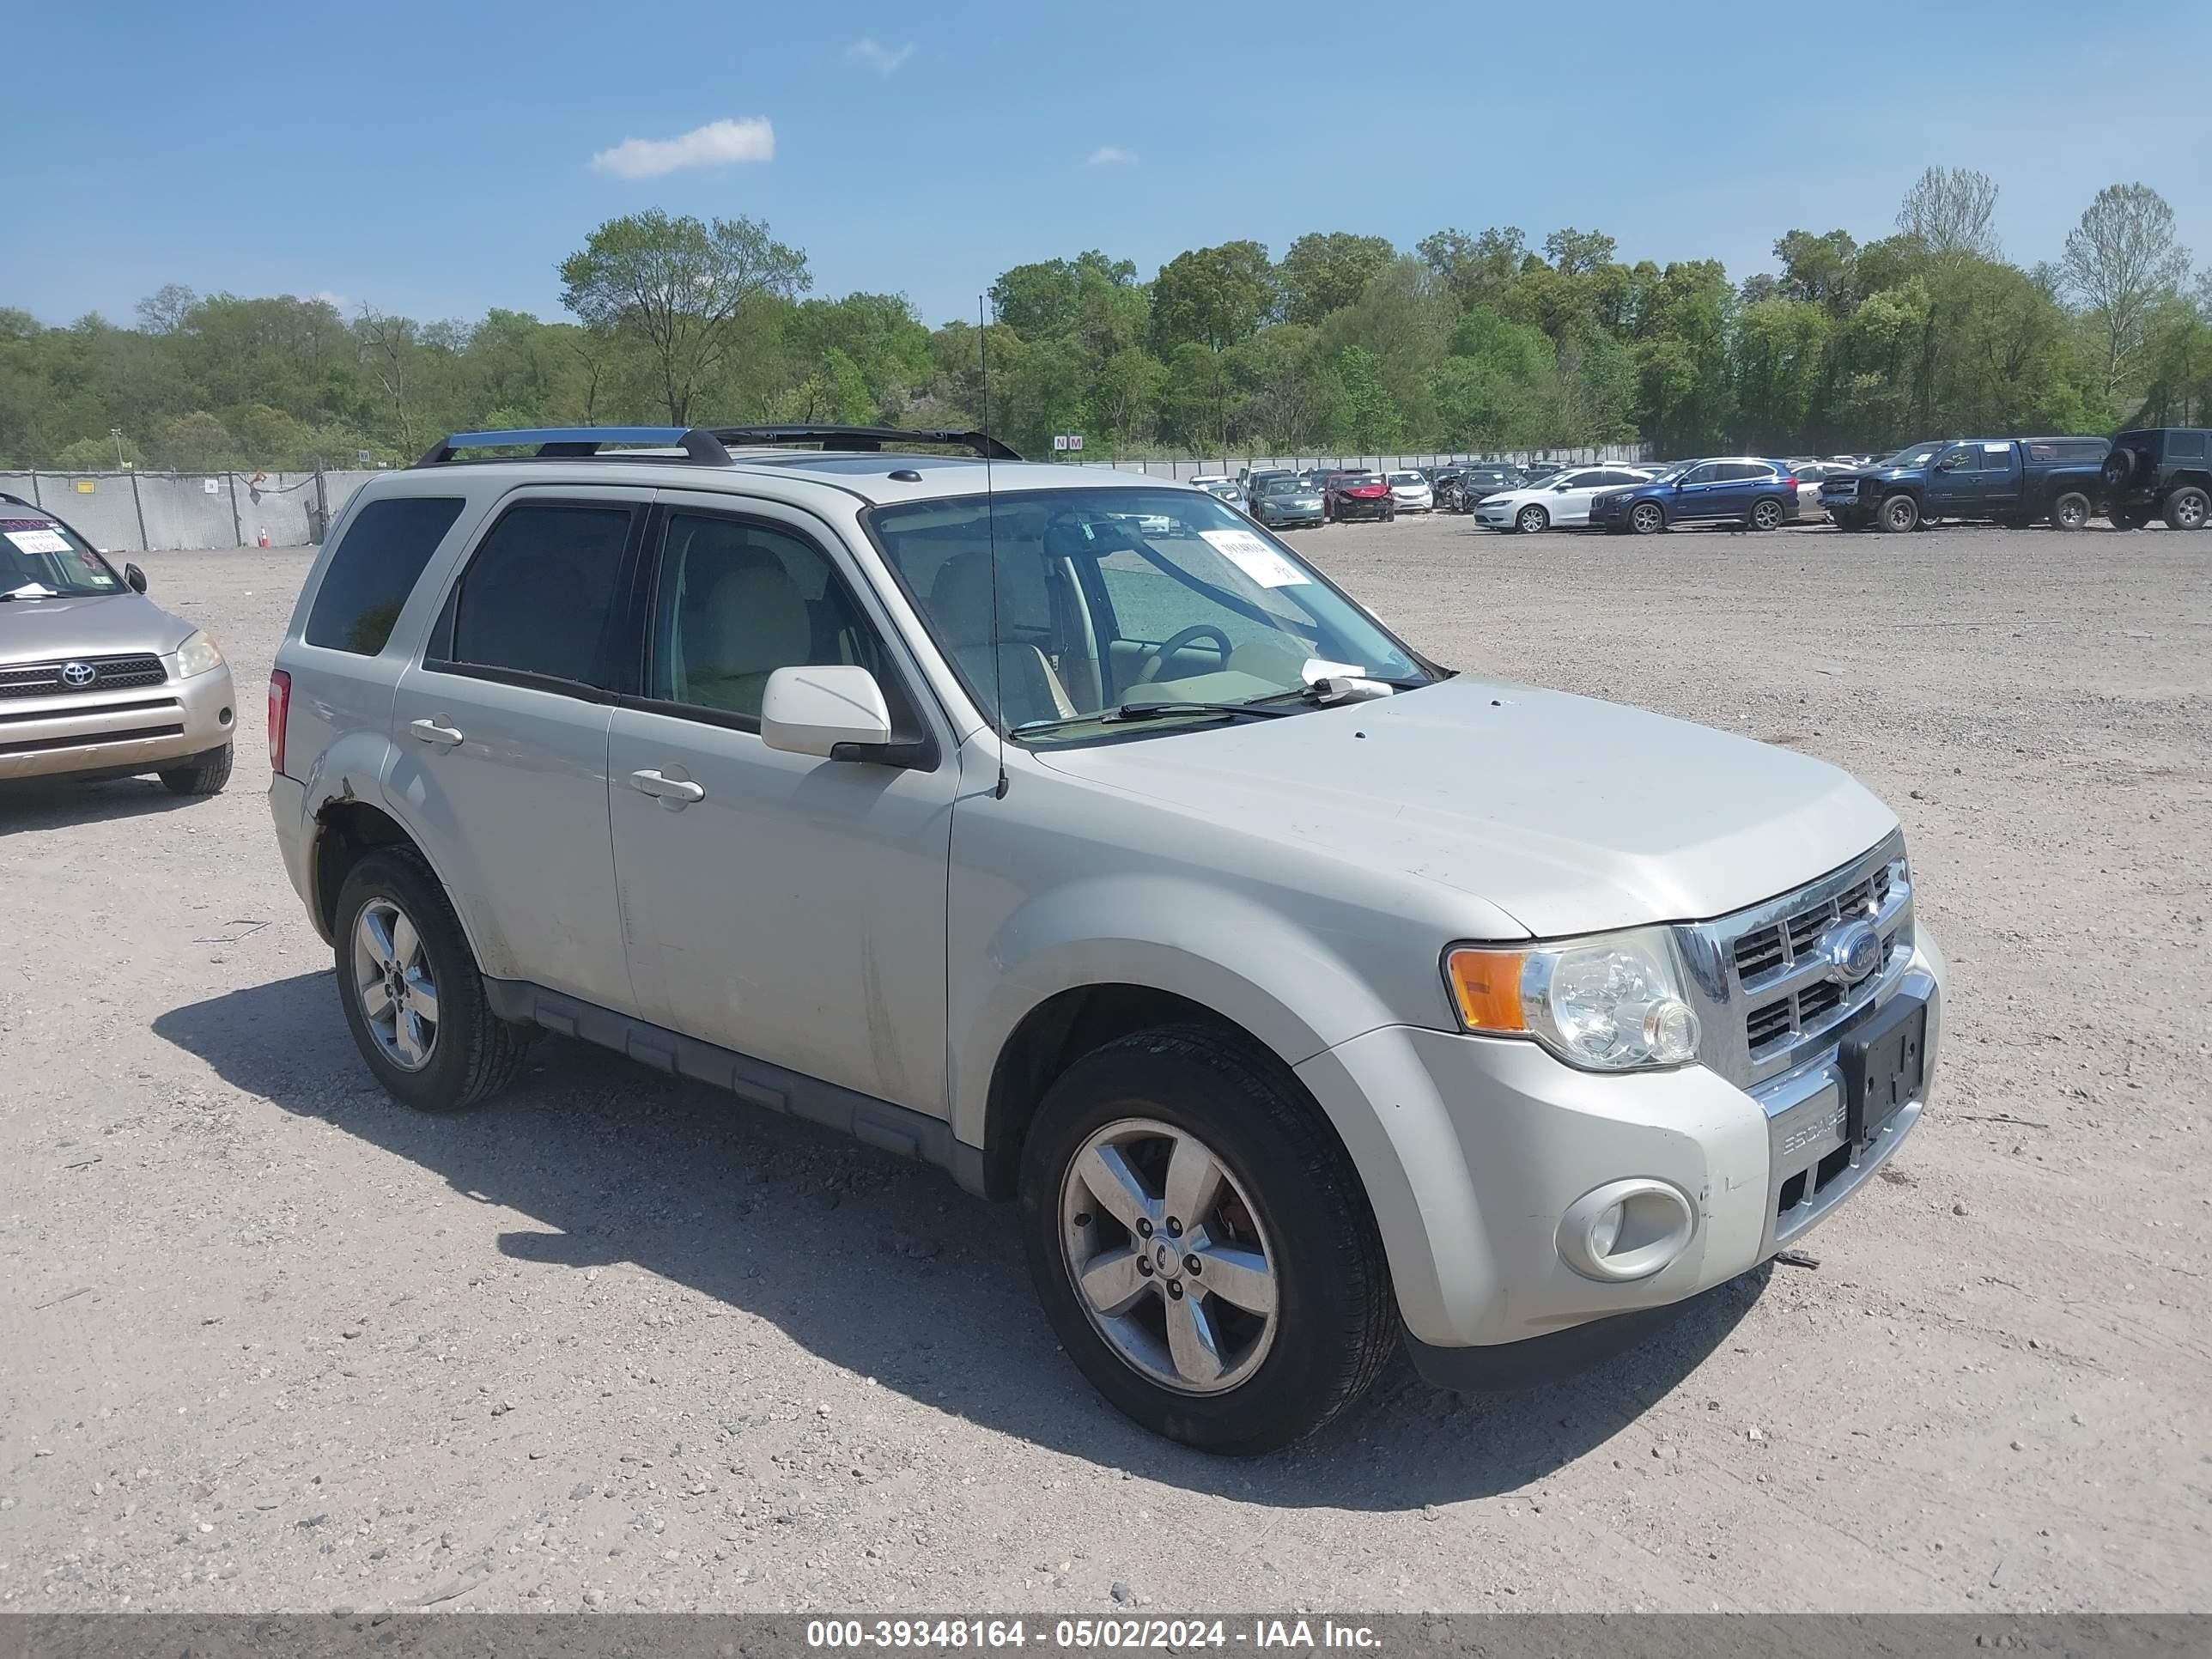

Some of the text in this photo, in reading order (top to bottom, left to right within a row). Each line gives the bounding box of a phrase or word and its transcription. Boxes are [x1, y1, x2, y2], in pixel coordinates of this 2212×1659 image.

[1057, 439, 1065, 447] N
[1071, 439, 1081, 447] M
[1856, 937, 1877, 968] Ford
[1784, 1103, 1846, 1156] ESCAPE
